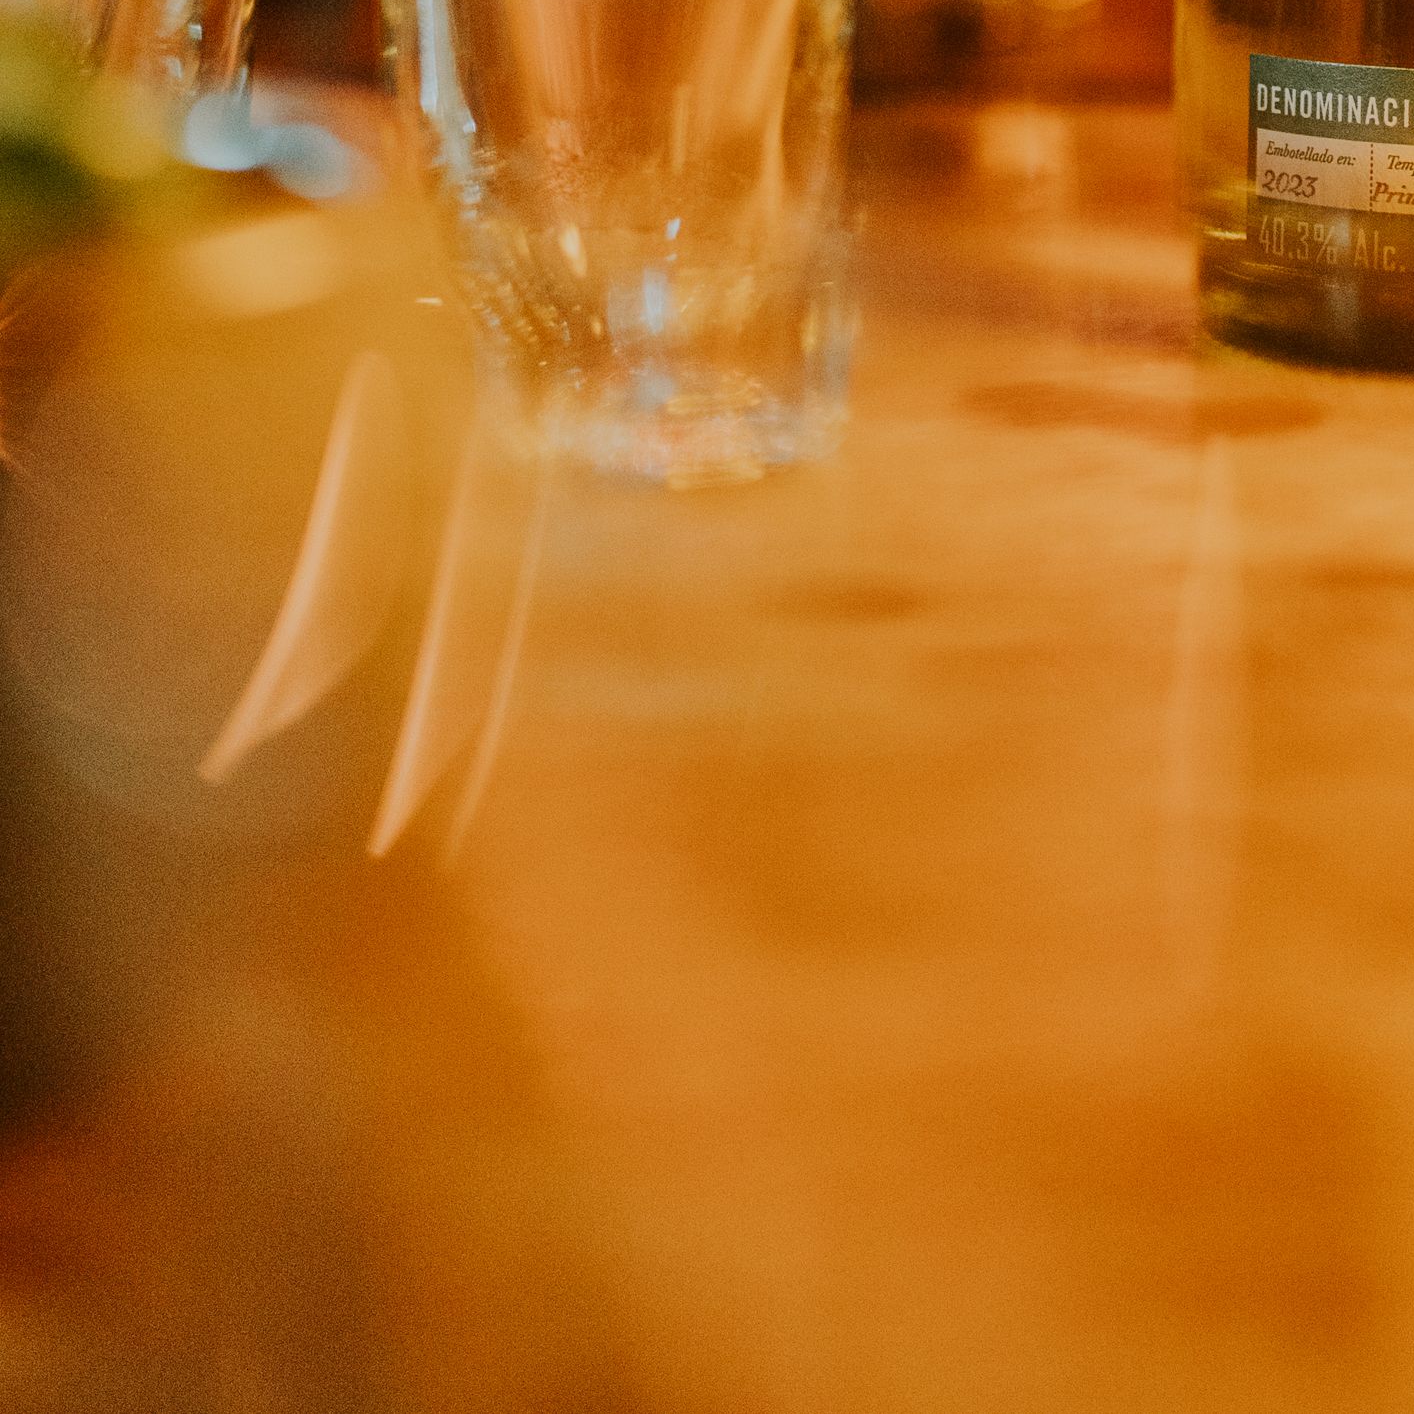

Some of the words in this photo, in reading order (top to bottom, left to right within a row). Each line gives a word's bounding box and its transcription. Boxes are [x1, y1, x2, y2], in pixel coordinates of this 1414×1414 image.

[1265, 140, 1333, 164] Embotellado
[1337, 153, 1356, 167] en:
[1262, 170, 1318, 198] 2023
[1354, 227, 1406, 272] Alc.
